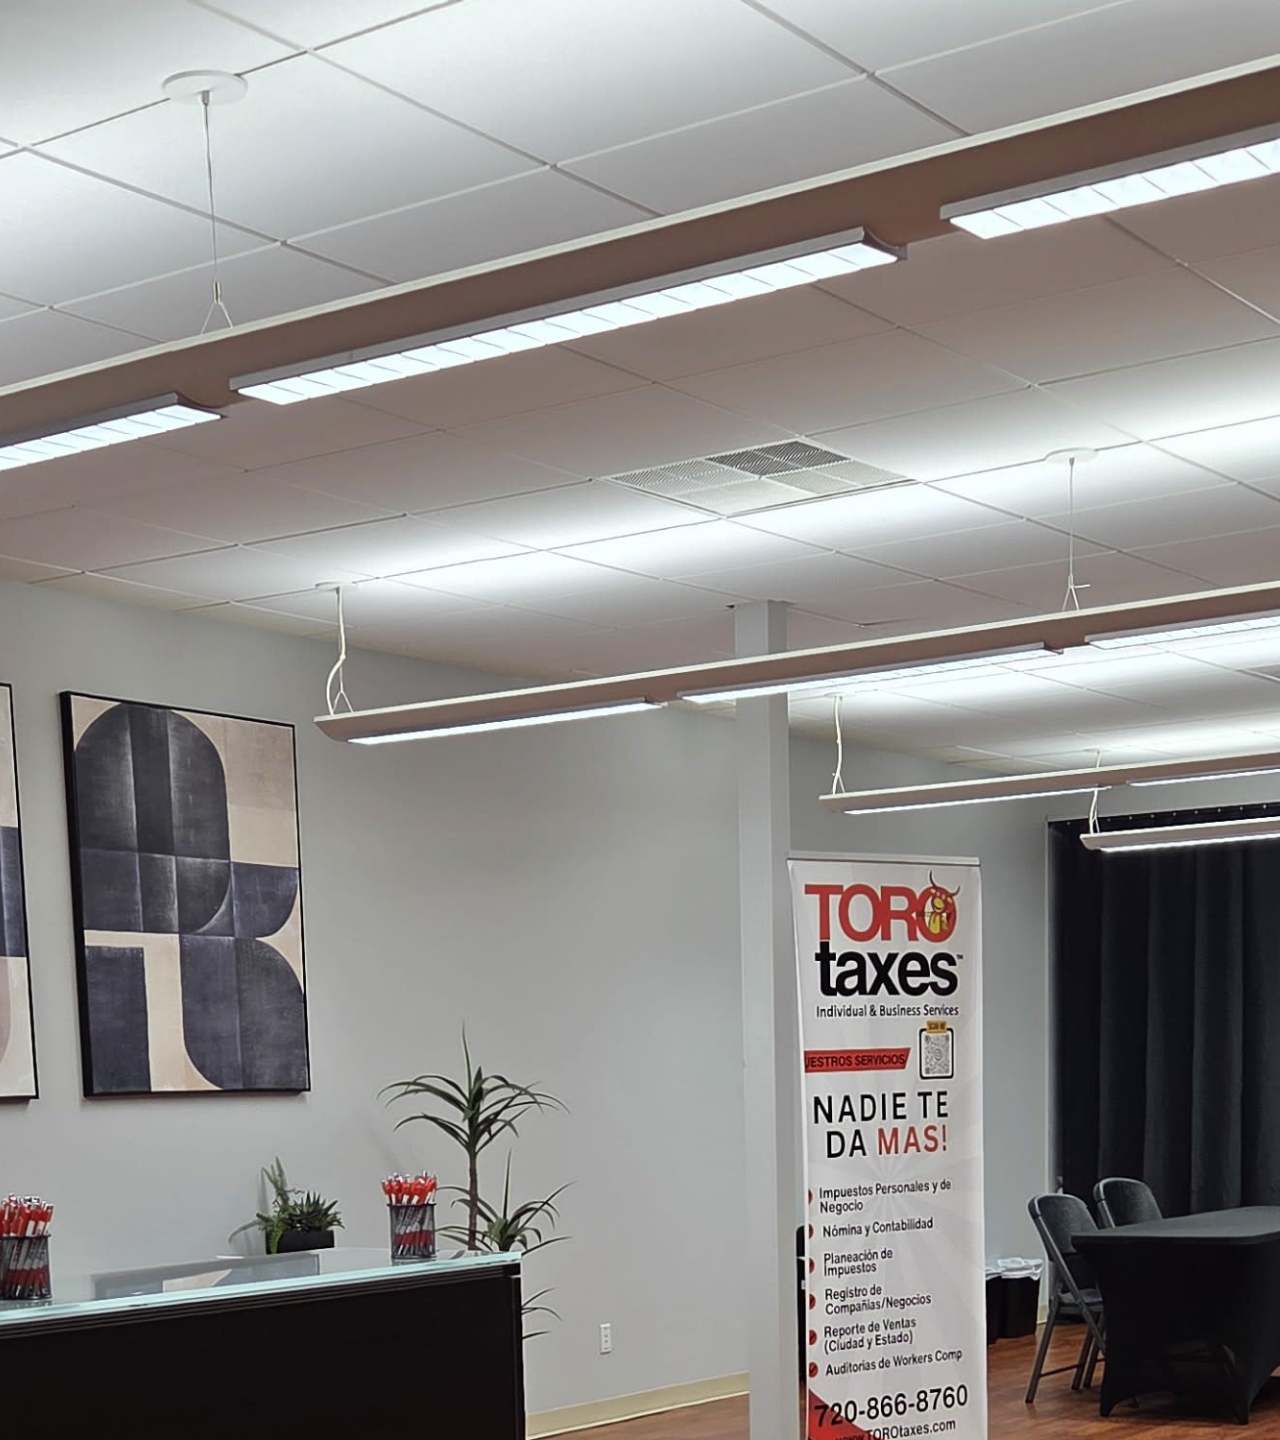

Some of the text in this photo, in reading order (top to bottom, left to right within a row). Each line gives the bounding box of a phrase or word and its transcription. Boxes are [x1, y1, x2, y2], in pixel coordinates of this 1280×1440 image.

[804, 883, 957, 943] TORO
[815, 941, 958, 997] taxes
[816, 1003, 960, 1018] Individual & Business Services
[854, 1053, 905, 1066] SERVICIOS
[813, 1090, 949, 1124] NADIE TE
[826, 1124, 947, 1158] DA MAS!
[819, 1179, 951, 1201] Impuestos Personales y de
[820, 1200, 864, 1215] Negocio
[822, 1217, 933, 1237] Nómina y Contabilidad
[823, 1247, 893, 1264] Planeación de
[823, 1262, 877, 1278] Impuestos
[825, 1284, 882, 1302] Registro de
[823, 1317, 917, 1338] Reporte de Ventas
[824, 1330, 913, 1355] (Ciudad y Estado)
[878, 1357, 891, 1369] de
[893, 1353, 933, 1367] Workers
[935, 1349, 963, 1361] Comp
[814, 1383, 968, 1427] 720-866-8760
